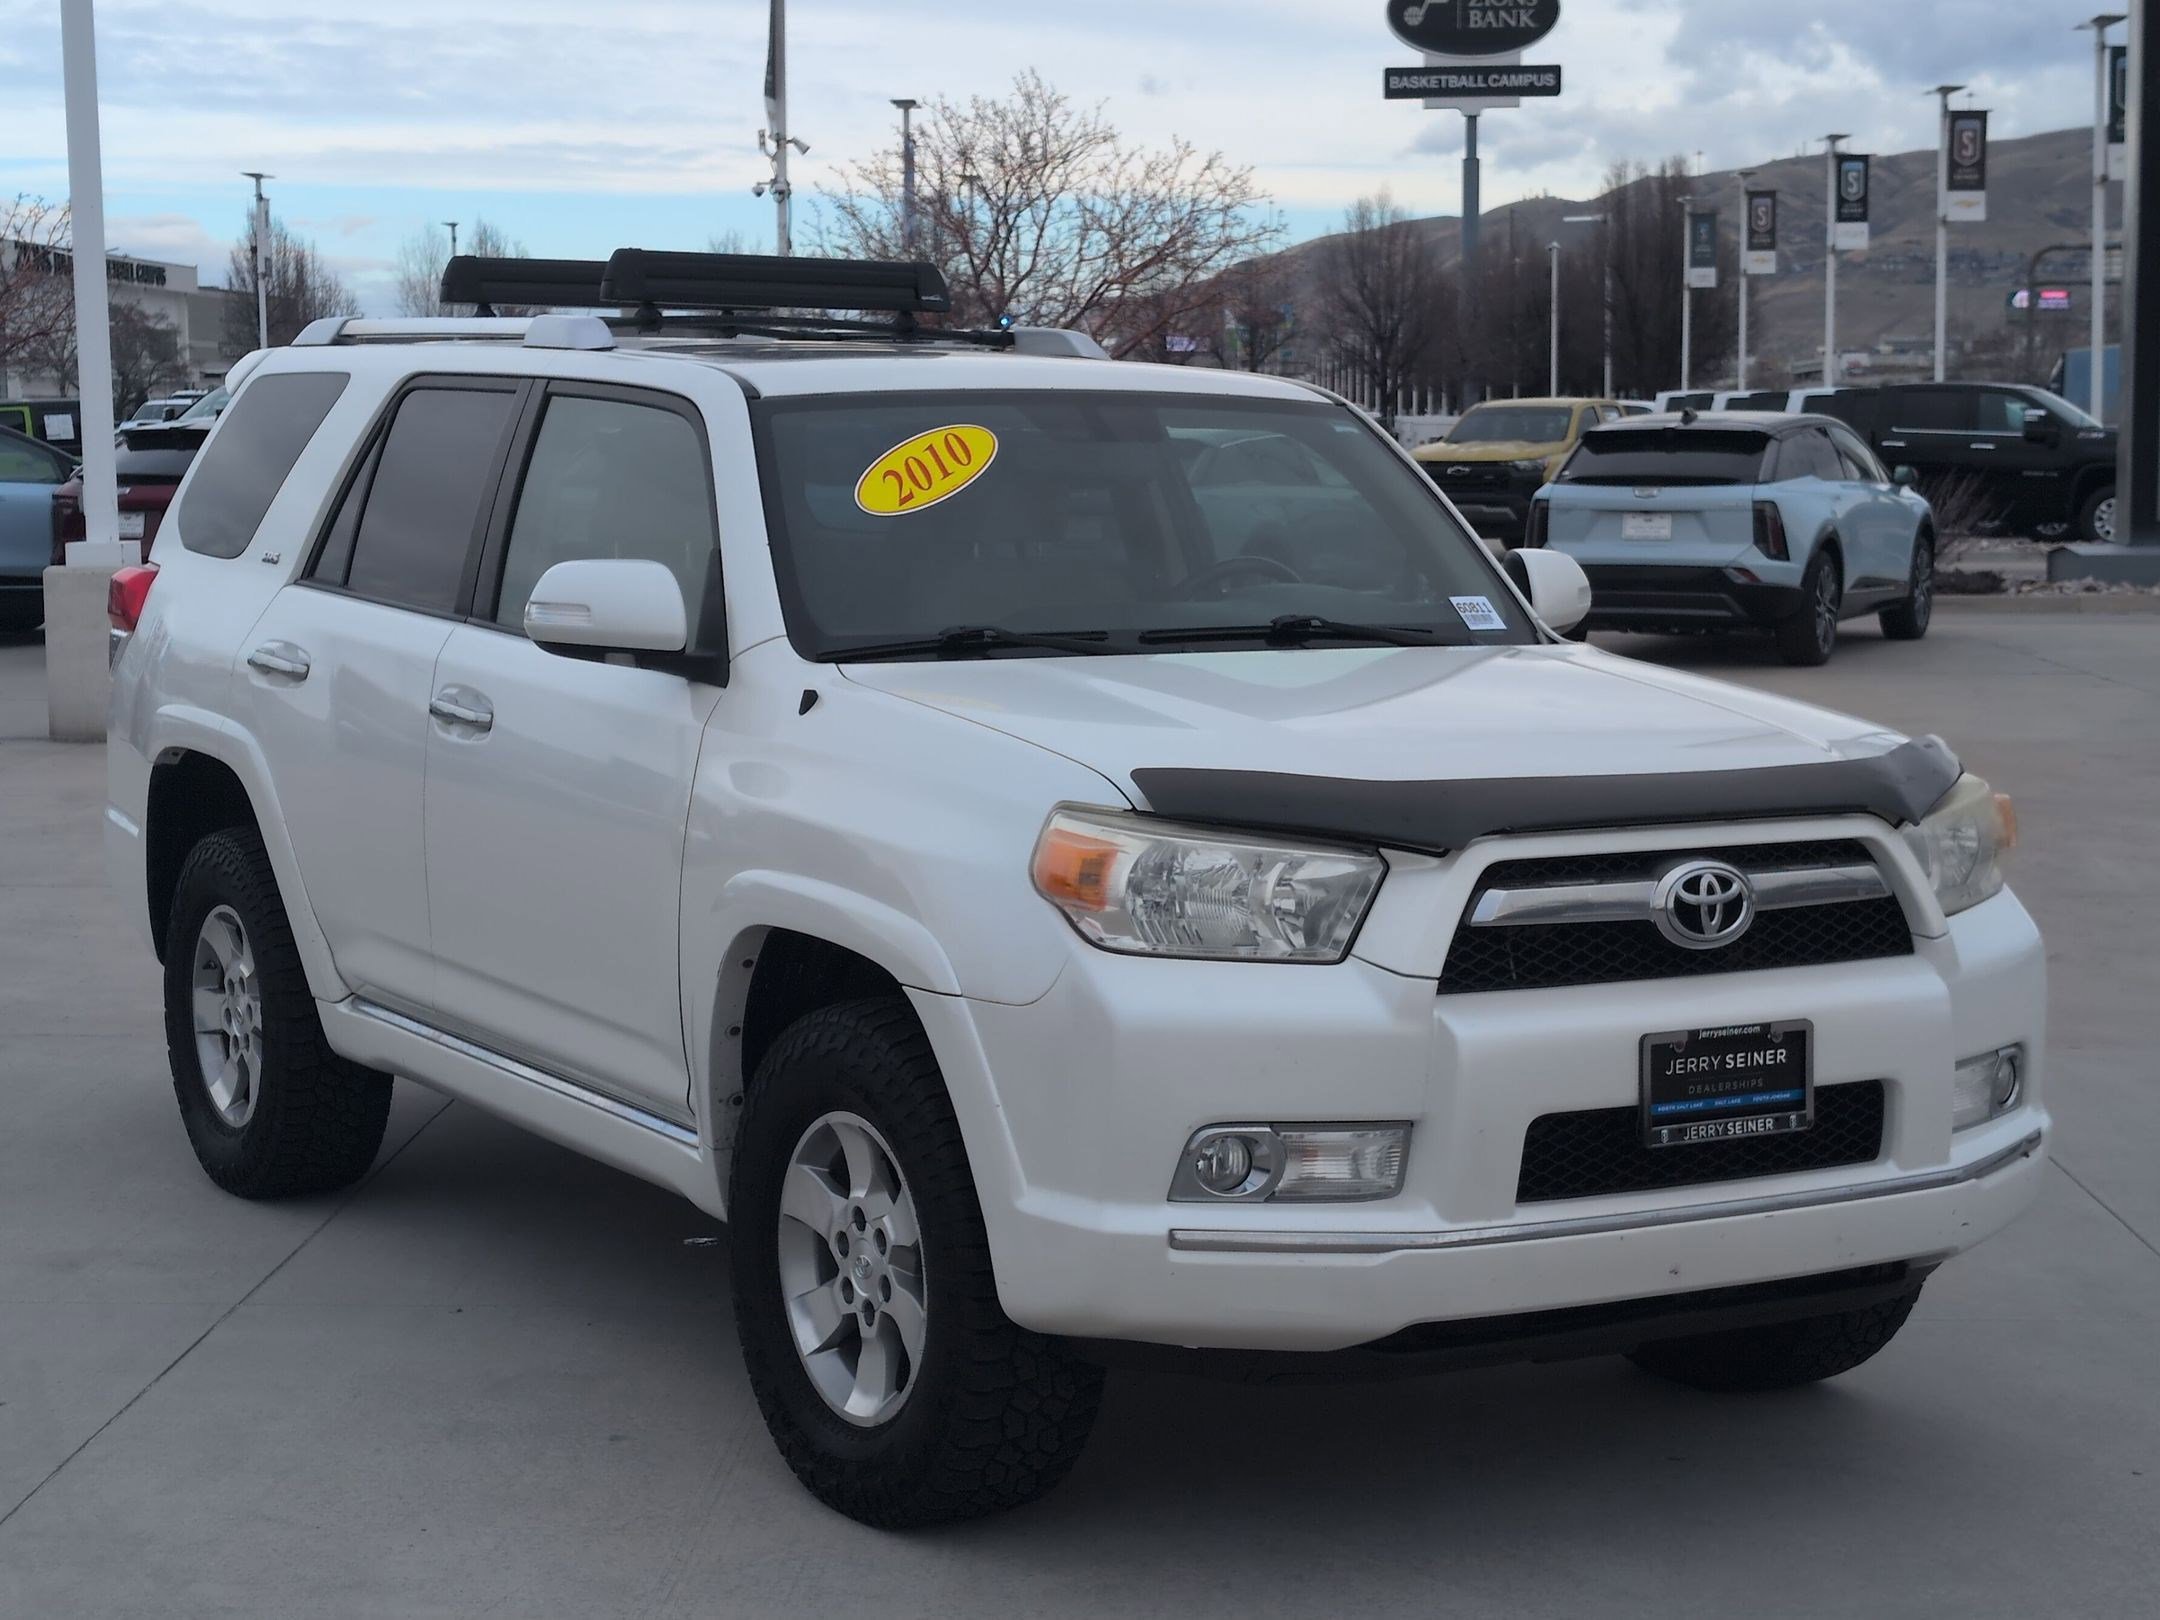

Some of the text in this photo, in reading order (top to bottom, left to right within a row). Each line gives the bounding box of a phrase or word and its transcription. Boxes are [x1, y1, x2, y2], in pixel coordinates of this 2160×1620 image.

[1469, 9, 1538, 28] BANK
[1389, 73, 1556, 89] BASKETBALL CAMPUS
[882, 432, 972, 507] 2010
[1456, 602, 1492, 613] 60811
[1698, 1025, 1761, 1040] jerryseiner.com
[1665, 1049, 1787, 1075] JERRY SEINER
[1688, 1078, 1764, 1095] DEALERSHIPS
[1728, 1097, 1741, 1105] LAKE
[1683, 1118, 1774, 1141] JERRY SEINER
